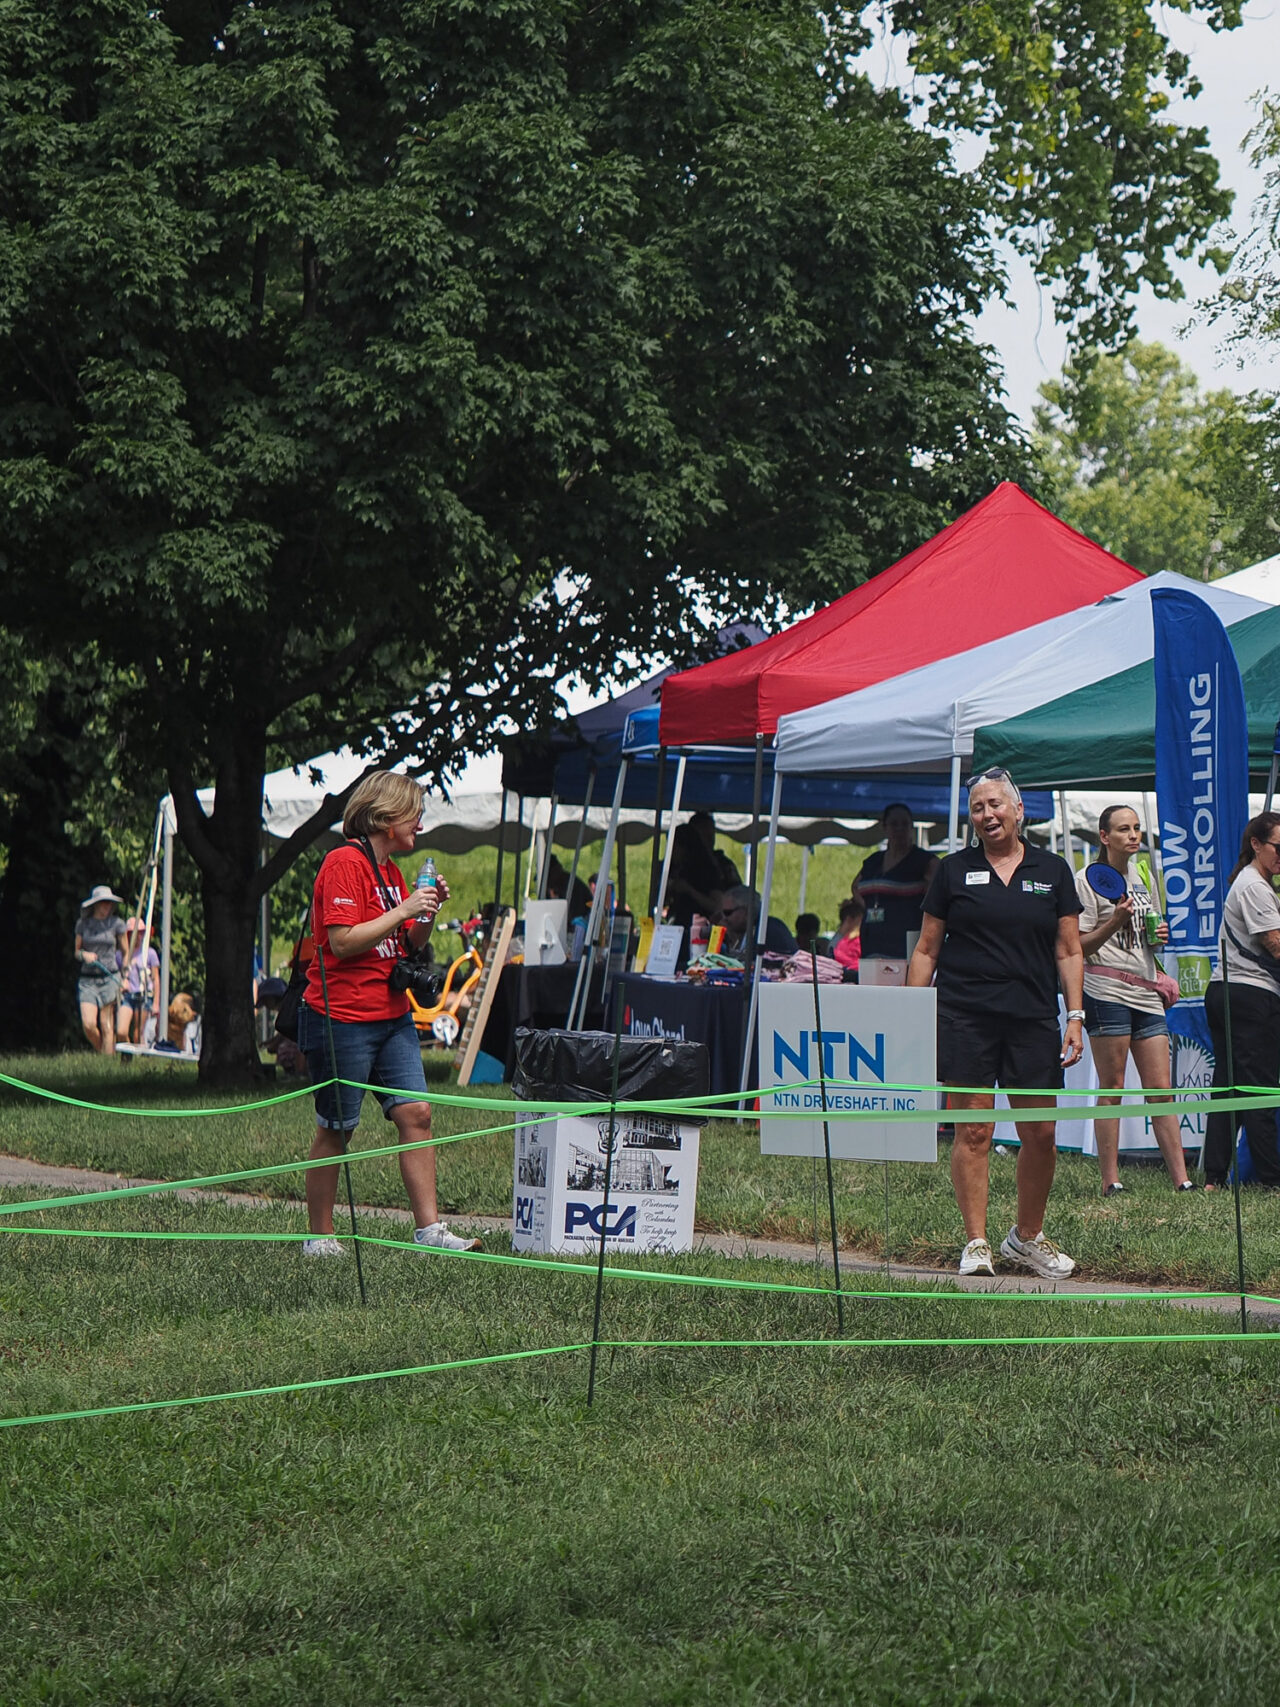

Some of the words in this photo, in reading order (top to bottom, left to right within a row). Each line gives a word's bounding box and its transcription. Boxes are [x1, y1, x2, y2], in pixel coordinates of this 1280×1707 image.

[1189, 672, 1216, 939] ENROLLING
[1162, 820, 1192, 939] NOW
[773, 1029, 885, 1084] NTN
[773, 1092, 800, 1107] NTN
[803, 1093, 890, 1111] DRVESHAFT,
[564, 1202, 638, 1237] PCA
[641, 1198, 680, 1213] Partnering
